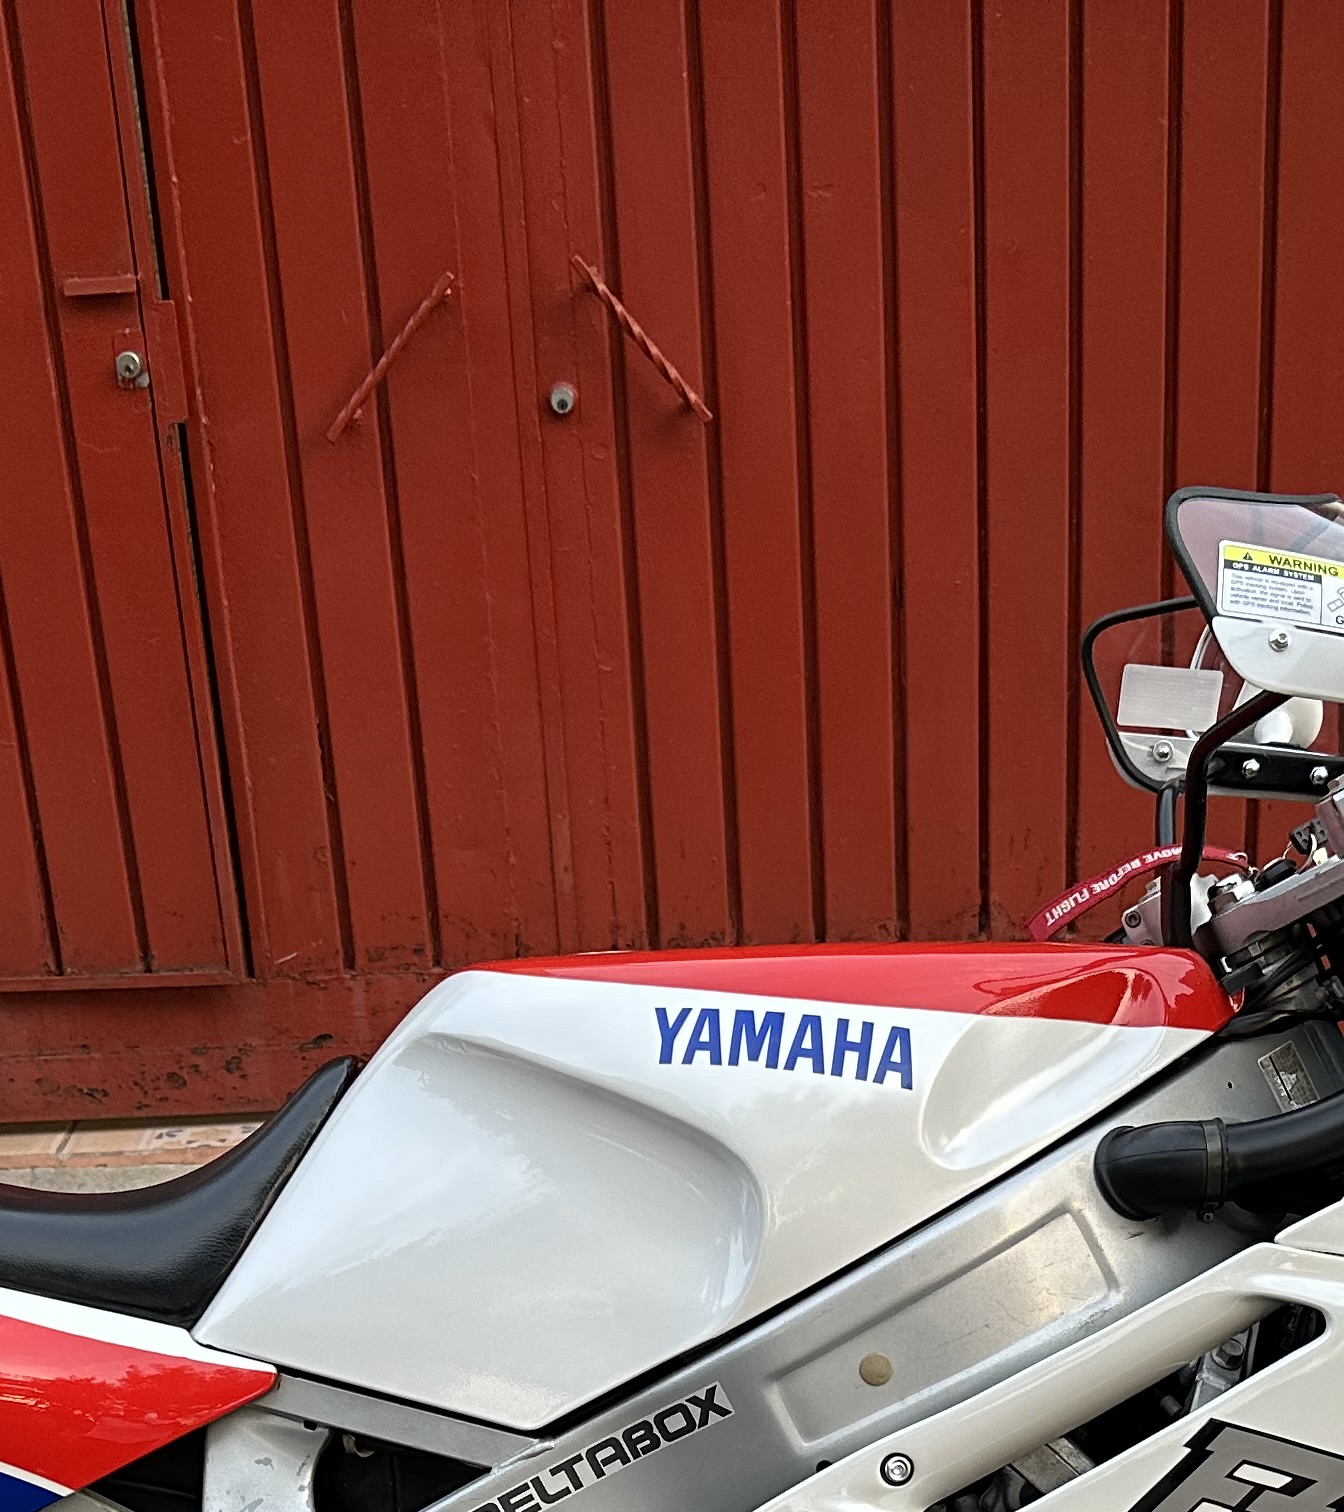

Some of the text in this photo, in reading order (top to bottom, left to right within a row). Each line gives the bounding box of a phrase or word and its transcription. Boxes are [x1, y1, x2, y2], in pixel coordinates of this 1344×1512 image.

[1232, 562, 1315, 581] GPS ALARM SYSTEM
[1268, 554, 1339, 577] WARNING
[1045, 846, 1183, 927] MOVE BEFORE FLIGHT
[654, 1006, 914, 1091] YAMAHA
